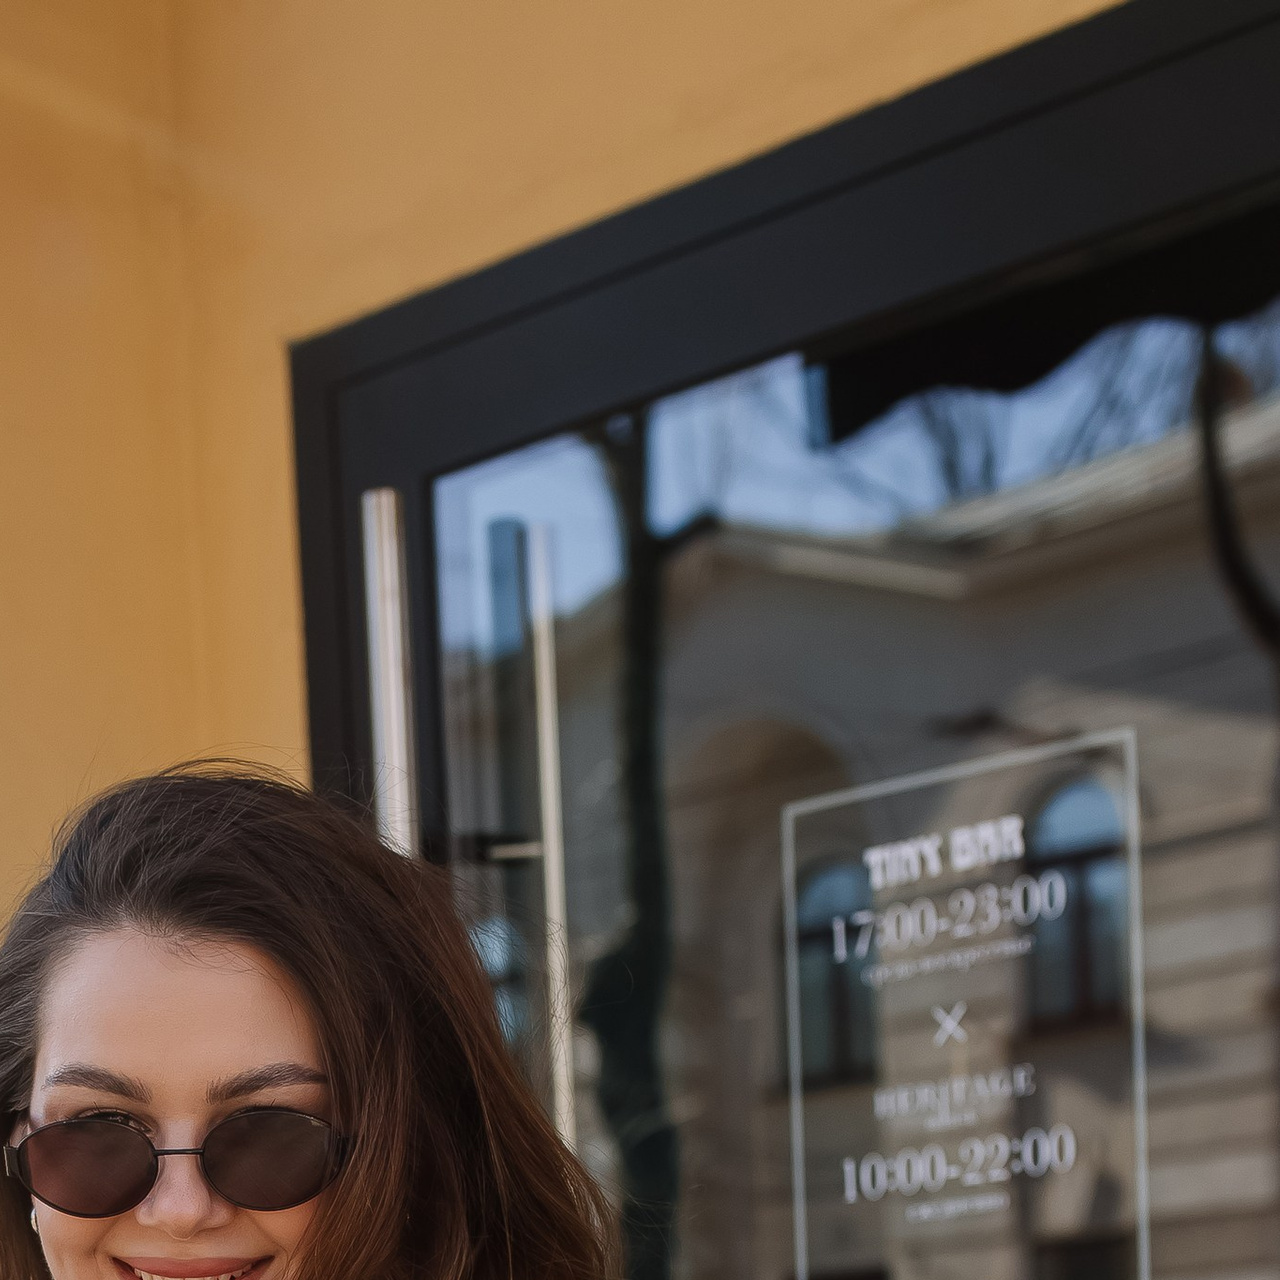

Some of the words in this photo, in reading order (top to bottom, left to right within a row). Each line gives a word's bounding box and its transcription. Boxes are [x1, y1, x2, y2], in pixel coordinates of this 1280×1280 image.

[862, 833, 943, 891] TINY
[831, 869, 1068, 964] 17:00-23:00
[841, 1122, 1078, 1205] 10:00-22:00
